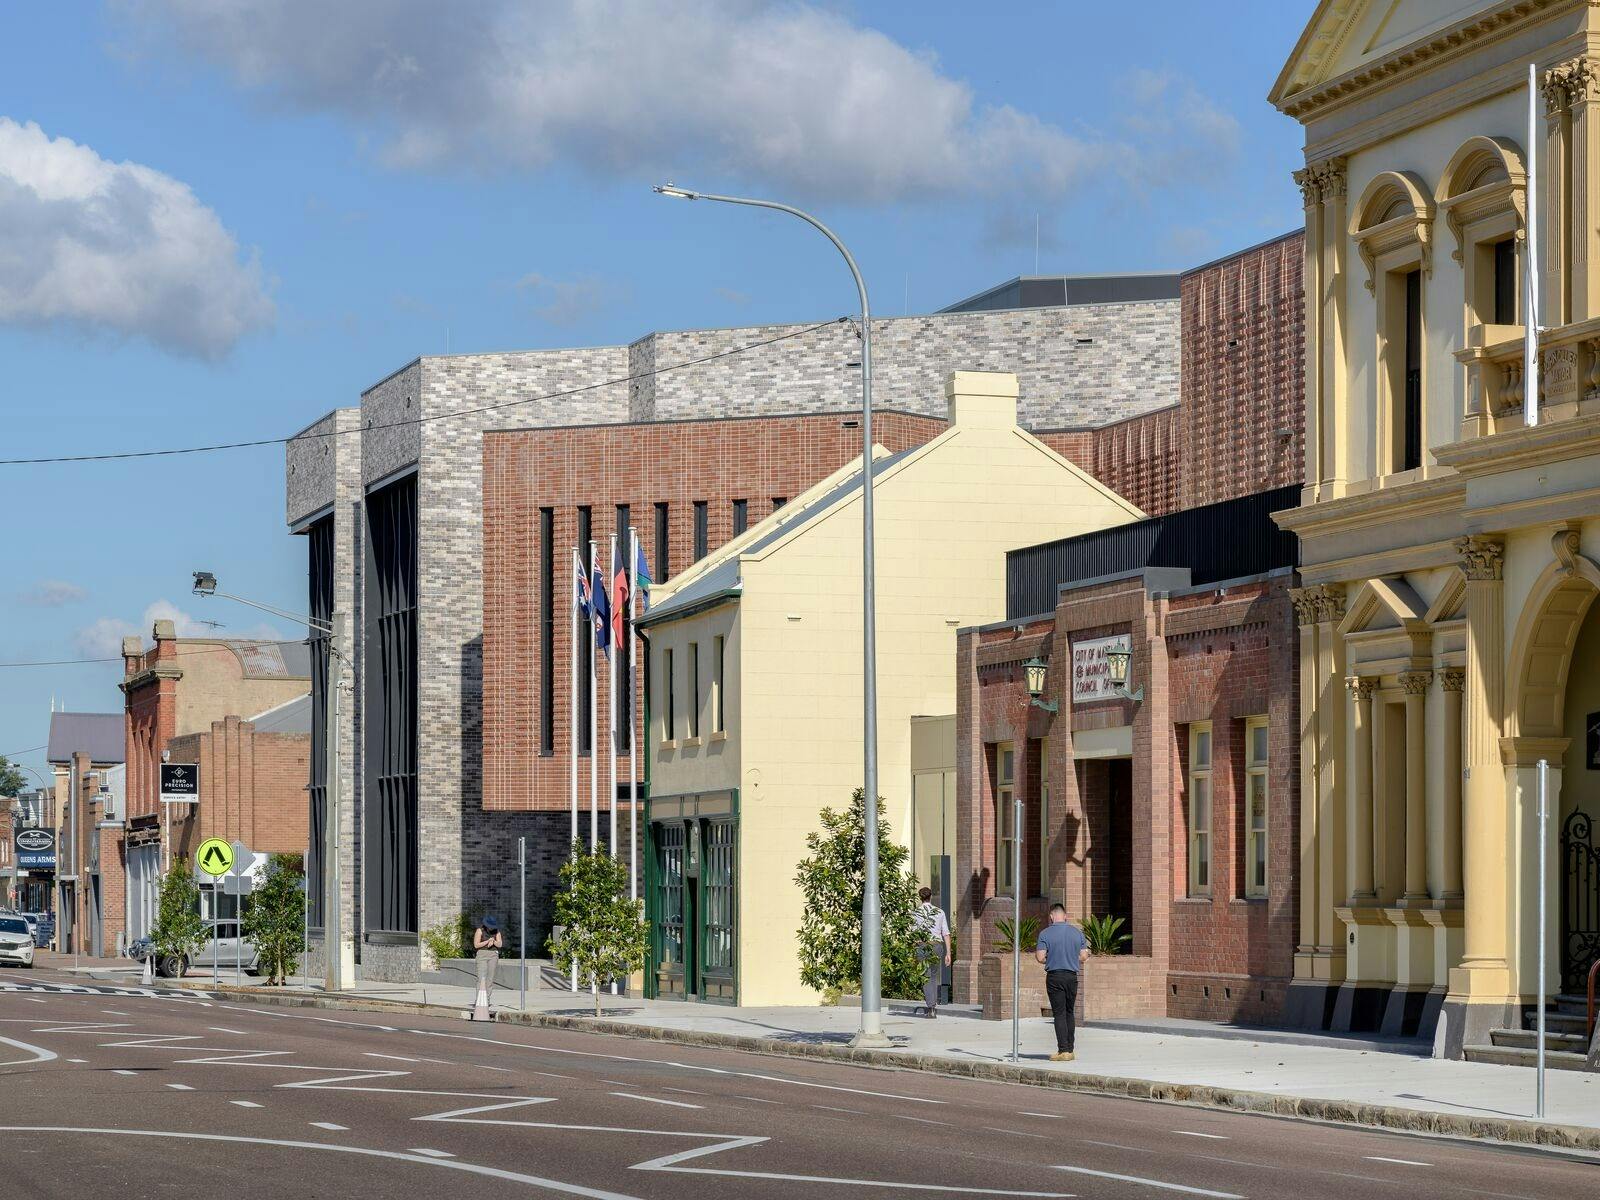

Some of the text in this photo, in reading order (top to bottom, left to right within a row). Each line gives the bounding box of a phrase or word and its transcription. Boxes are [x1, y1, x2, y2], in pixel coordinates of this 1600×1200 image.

[1075, 648, 1088, 662] CITY
[1088, 647, 1096, 660] OF
[1075, 680, 1099, 694] COUNCIL
